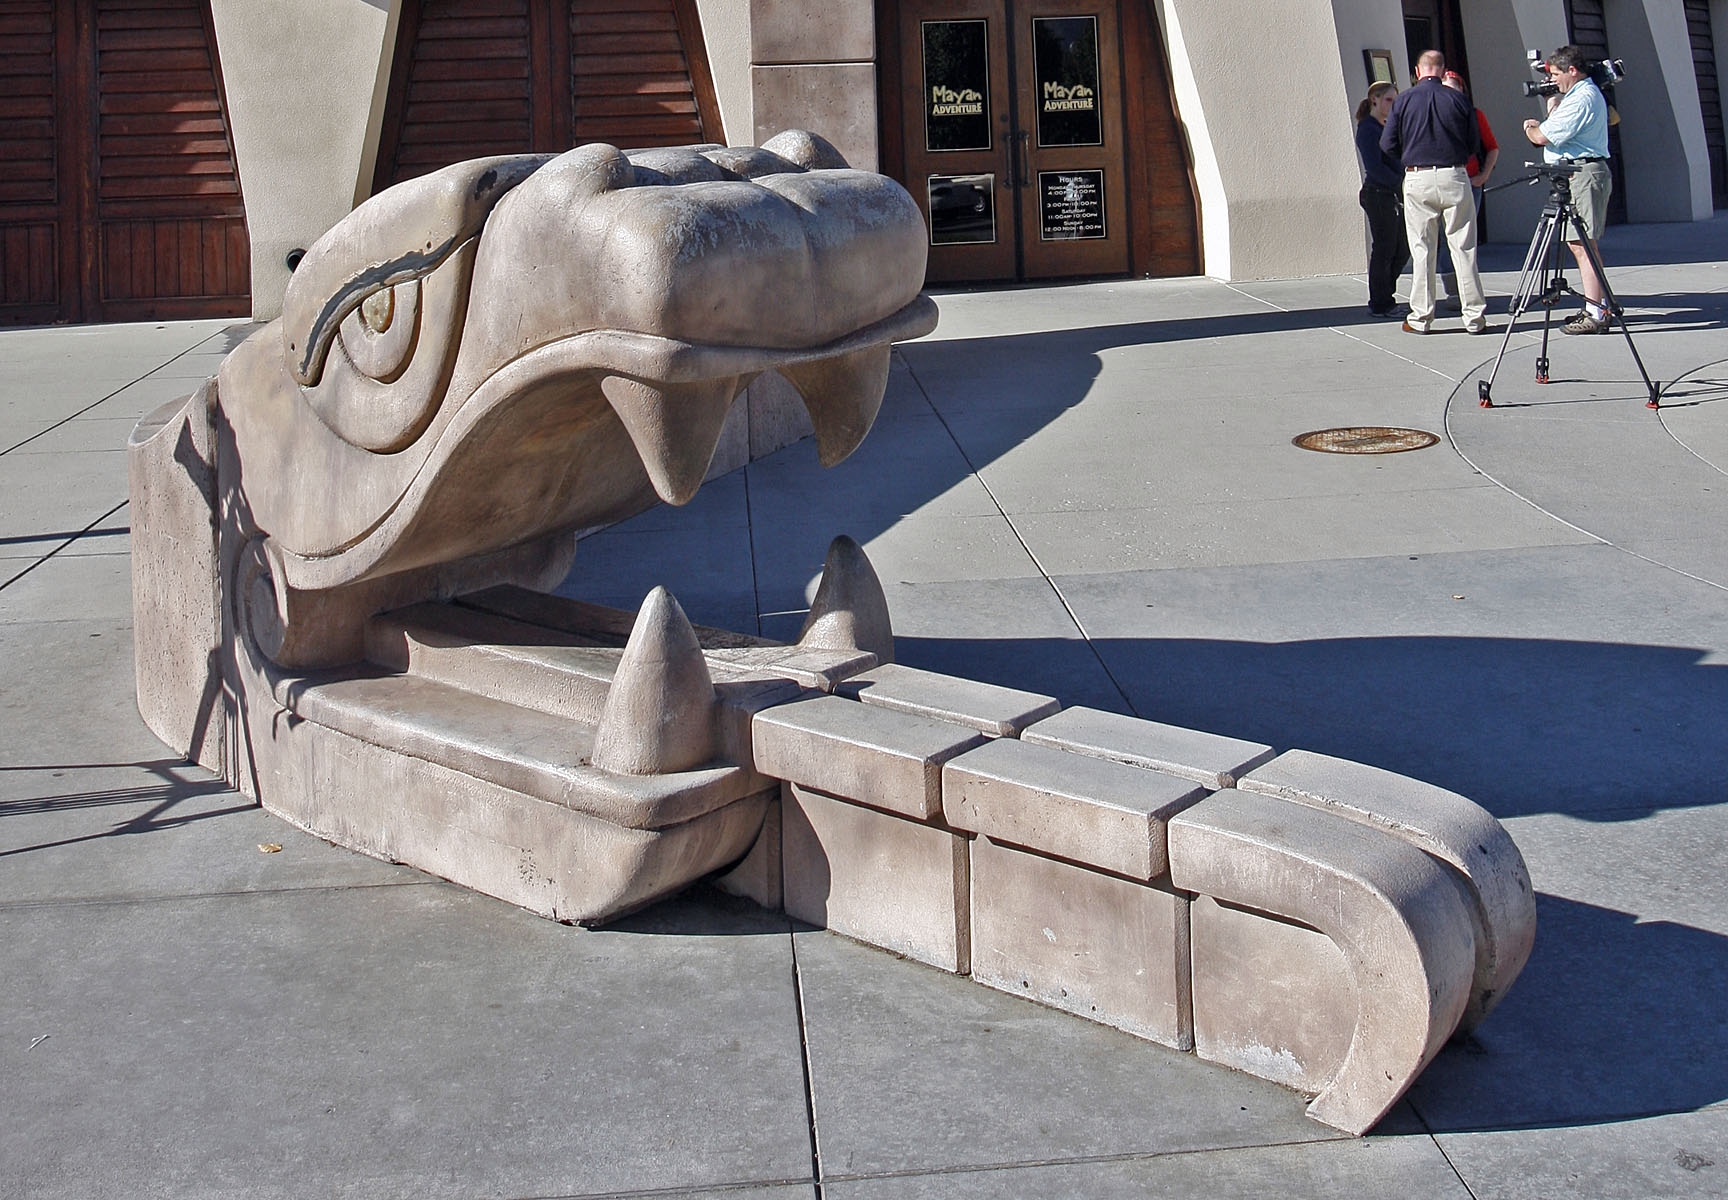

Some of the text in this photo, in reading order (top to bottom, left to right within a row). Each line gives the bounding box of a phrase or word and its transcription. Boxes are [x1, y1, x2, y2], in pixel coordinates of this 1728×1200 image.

[932, 85, 982, 103] Mayan
[1044, 81, 1093, 100] Mayan
[932, 102, 982, 115] ADVENTURE
[1044, 98, 1093, 111] ADVENTURE
